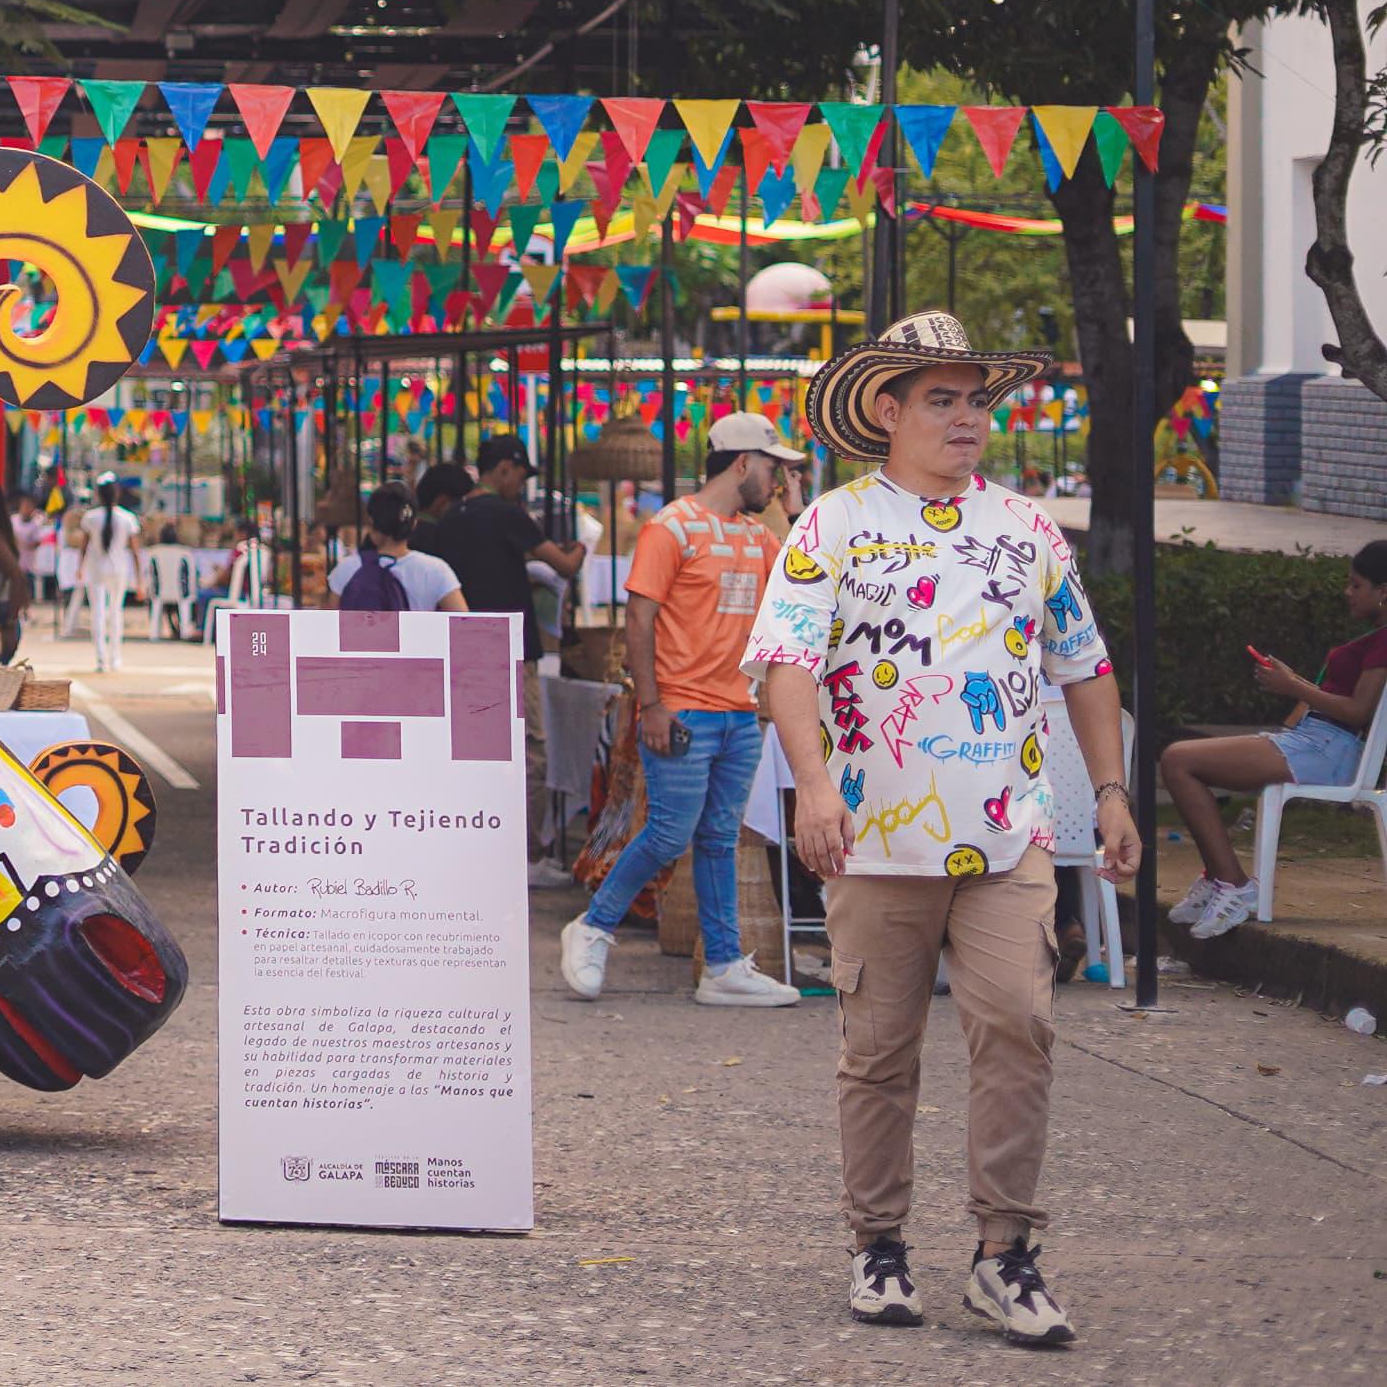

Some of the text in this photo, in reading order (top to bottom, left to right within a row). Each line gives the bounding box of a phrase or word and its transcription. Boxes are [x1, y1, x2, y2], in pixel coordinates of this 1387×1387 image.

[848, 530, 939, 574] Style
[982, 534, 1036, 610] KING
[839, 571, 897, 607] MAGIC
[845, 618, 932, 666] MOM
[750, 638, 821, 672] RAZY
[823, 660, 874, 756] KISS
[927, 734, 1017, 764] GRAFFITI
[241, 807, 500, 832] Tallando y Tejiendo
[241, 836, 362, 854] Tradición
[254, 883, 297, 893] Autor:
[254, 908, 483, 921] Formato: Macrofigura monumental.
[255, 928, 310, 939] Técnica:
[313, 929, 350, 940] Tallado
[369, 931, 402, 942] icopor
[426, 932, 501, 943] recubrimiento
[269, 942, 298, 953] papel
[354, 943, 440, 954] cuidadosamente
[444, 945, 493, 957] trabajado
[254, 954, 506, 969] para resaltar detalles y texturas que representan
[255, 967, 263, 976] la
[266, 967, 304, 977] esencia
[307, 967, 322, 978] del
[244, 1005, 511, 1022] Esta obra simboliza la riqueza cultural y
[244, 1021, 511, 1035] artesanal de Galapa, destacando el
[244, 1035, 512, 1053] legado de nuestros maestros artesanos y
[244, 1050, 512, 1066] su habilidad para transformar materiales
[275, 1069, 315, 1079] piezas
[332, 1069, 390, 1081] cargadas
[407, 1069, 422, 1079] de
[439, 1070, 489, 1081] historia
[503, 1073, 512, 1083] y
[311, 1083, 327, 1093] Un
[332, 1082, 394, 1096] homenaje
[411, 1084, 429, 1095] las
[490, 1089, 513, 1098] que
[245, 1098, 297, 1108] cuentan
[428, 1158, 463, 1167] Manos
[319, 1170, 363, 1180] GALAPA
[427, 1169, 471, 1177] cuentan
[428, 1178, 475, 1188] historias
